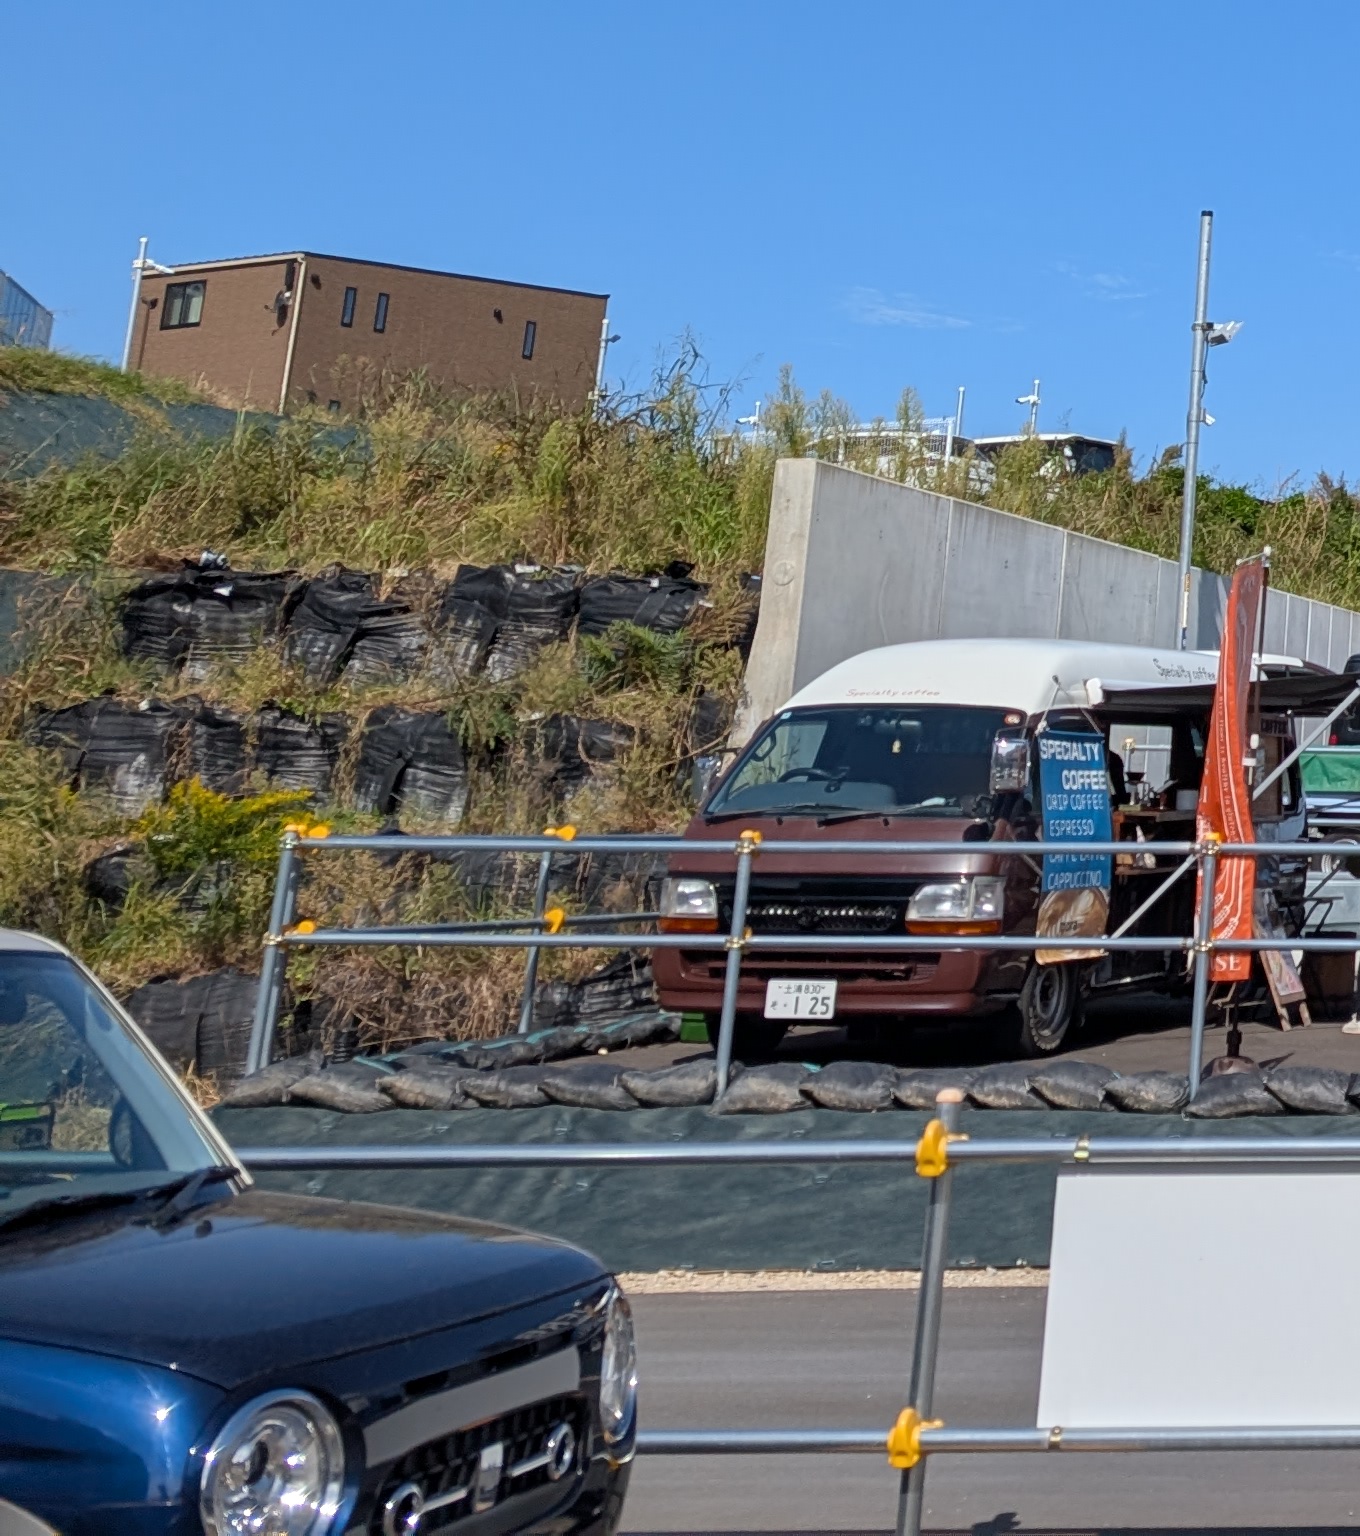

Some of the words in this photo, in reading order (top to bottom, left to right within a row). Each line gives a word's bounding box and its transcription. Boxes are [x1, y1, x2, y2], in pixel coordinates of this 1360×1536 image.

[846, 688, 900, 697] Specialty
[901, 688, 940, 696] coffee
[1040, 739, 1100, 762] SPECIALTY
[1062, 769, 1107, 791] COFFEE
[1046, 794, 1068, 810] DRIP
[1070, 794, 1104, 811] COFFEE
[1049, 819, 1094, 837] ESPRESSO
[1047, 870, 1102, 890] CAPPUCCINO
[1215, 954, 1241, 972] SE
[784, 984, 802, 995] 土浦
[804, 984, 821, 995] 830
